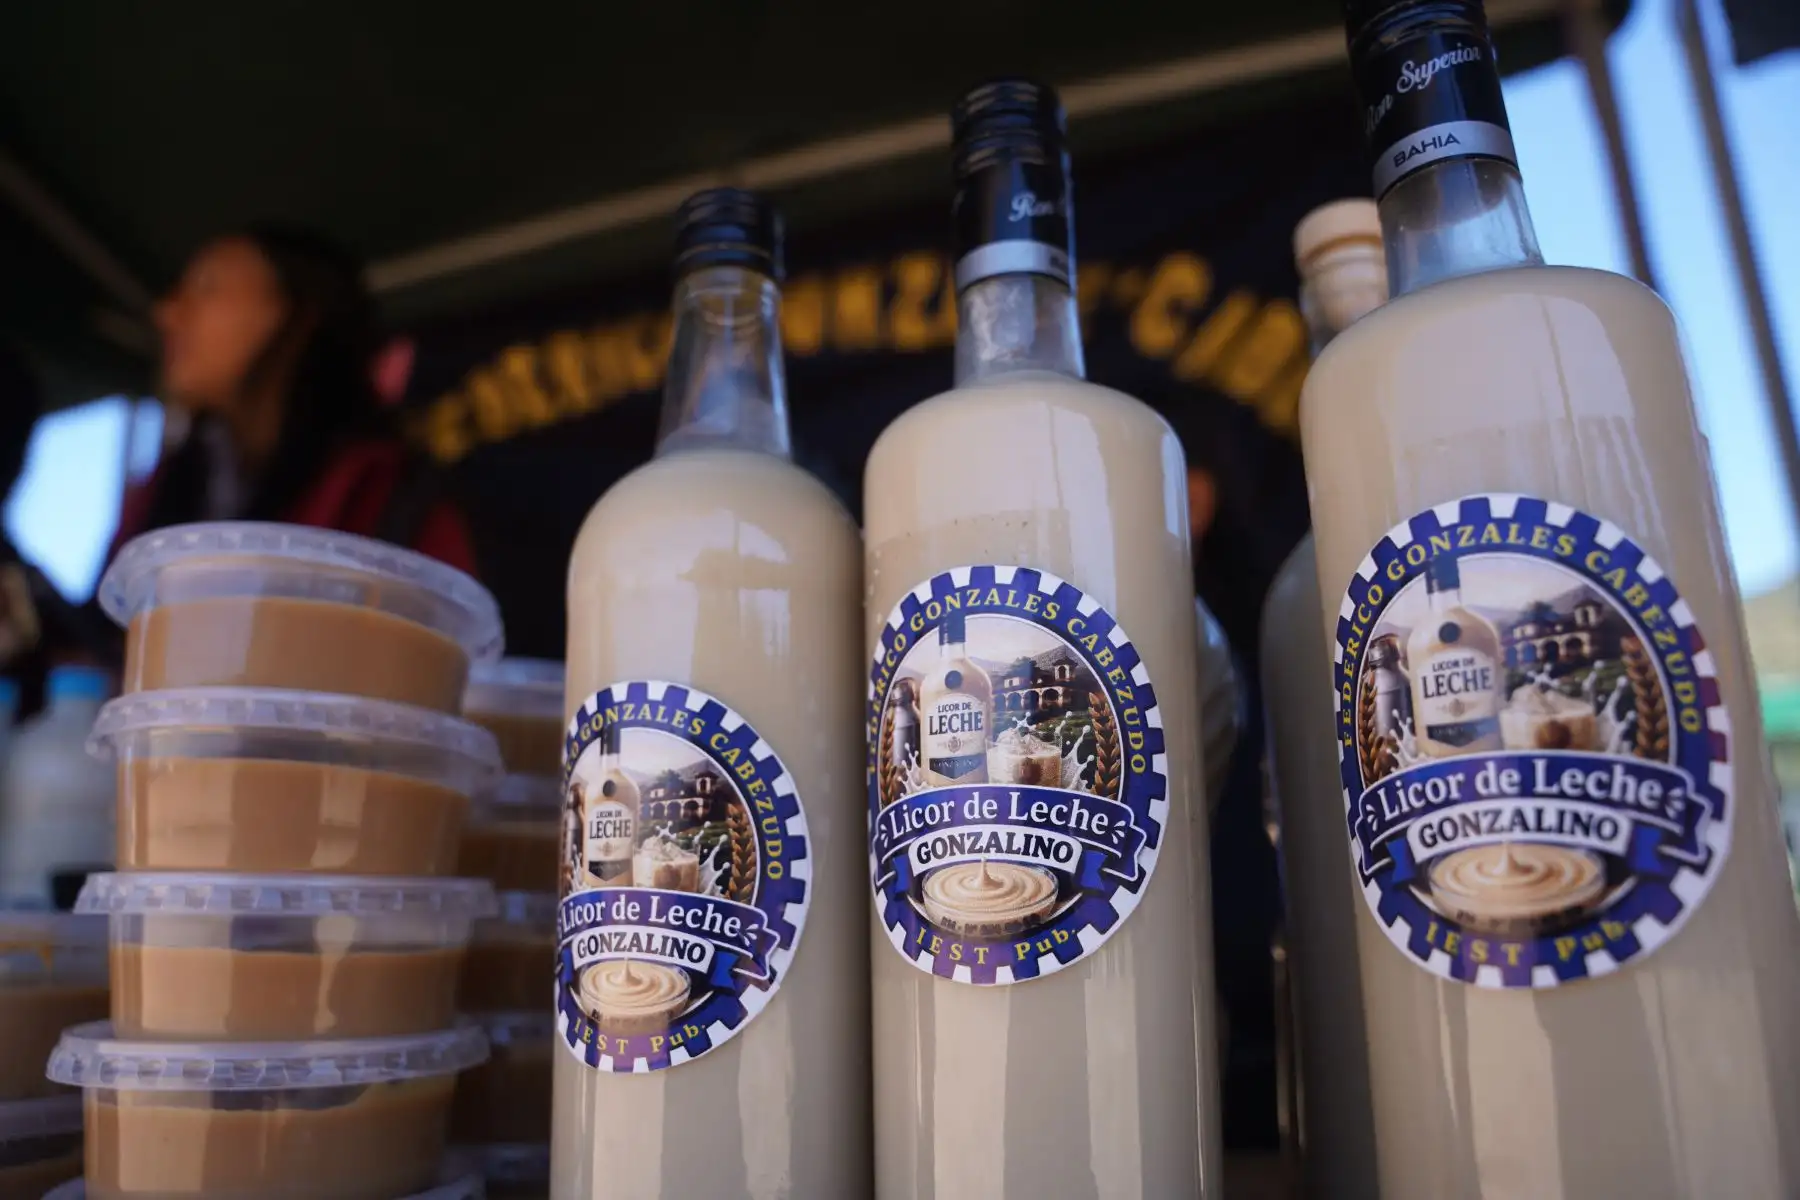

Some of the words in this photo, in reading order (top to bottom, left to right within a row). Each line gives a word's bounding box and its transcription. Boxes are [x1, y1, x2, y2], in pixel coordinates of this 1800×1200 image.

[1392, 132, 1461, 168] BAHIA
[1342, 583, 1384, 747] FEDERICO
[1386, 522, 1578, 581] GONZALES
[1585, 550, 1702, 733] CABEZUDO
[909, 588, 1061, 632] GONZALES
[1066, 617, 1146, 775] CABEZUDO
[1421, 667, 1493, 700] LECHE
[928, 711, 983, 736] LECHE
[938, 702, 961, 714] LICOR
[962, 701, 973, 711] DE
[579, 703, 706, 742] GONZALES
[709, 732, 784, 881] CABEZUDO
[1376, 774, 1465, 822] Licor
[1486, 761, 1522, 794] de
[1533, 759, 1662, 810] Leche
[589, 818, 632, 840] LECHE
[887, 800, 956, 838] Licor
[963, 791, 998, 820] de
[1008, 791, 1109, 836] Leche
[1418, 807, 1619, 849] GONZALINO
[915, 832, 1075, 866] GONZALINO
[561, 901, 605, 932] Licor
[612, 895, 641, 920] de
[648, 895, 741, 938] Leche
[577, 932, 707, 964] GONZALINO
[916, 927, 989, 965] IEST
[1014, 927, 1077, 961] Pub.
[574, 1018, 628, 1055] IEST
[650, 1023, 706, 1053] Pub.
